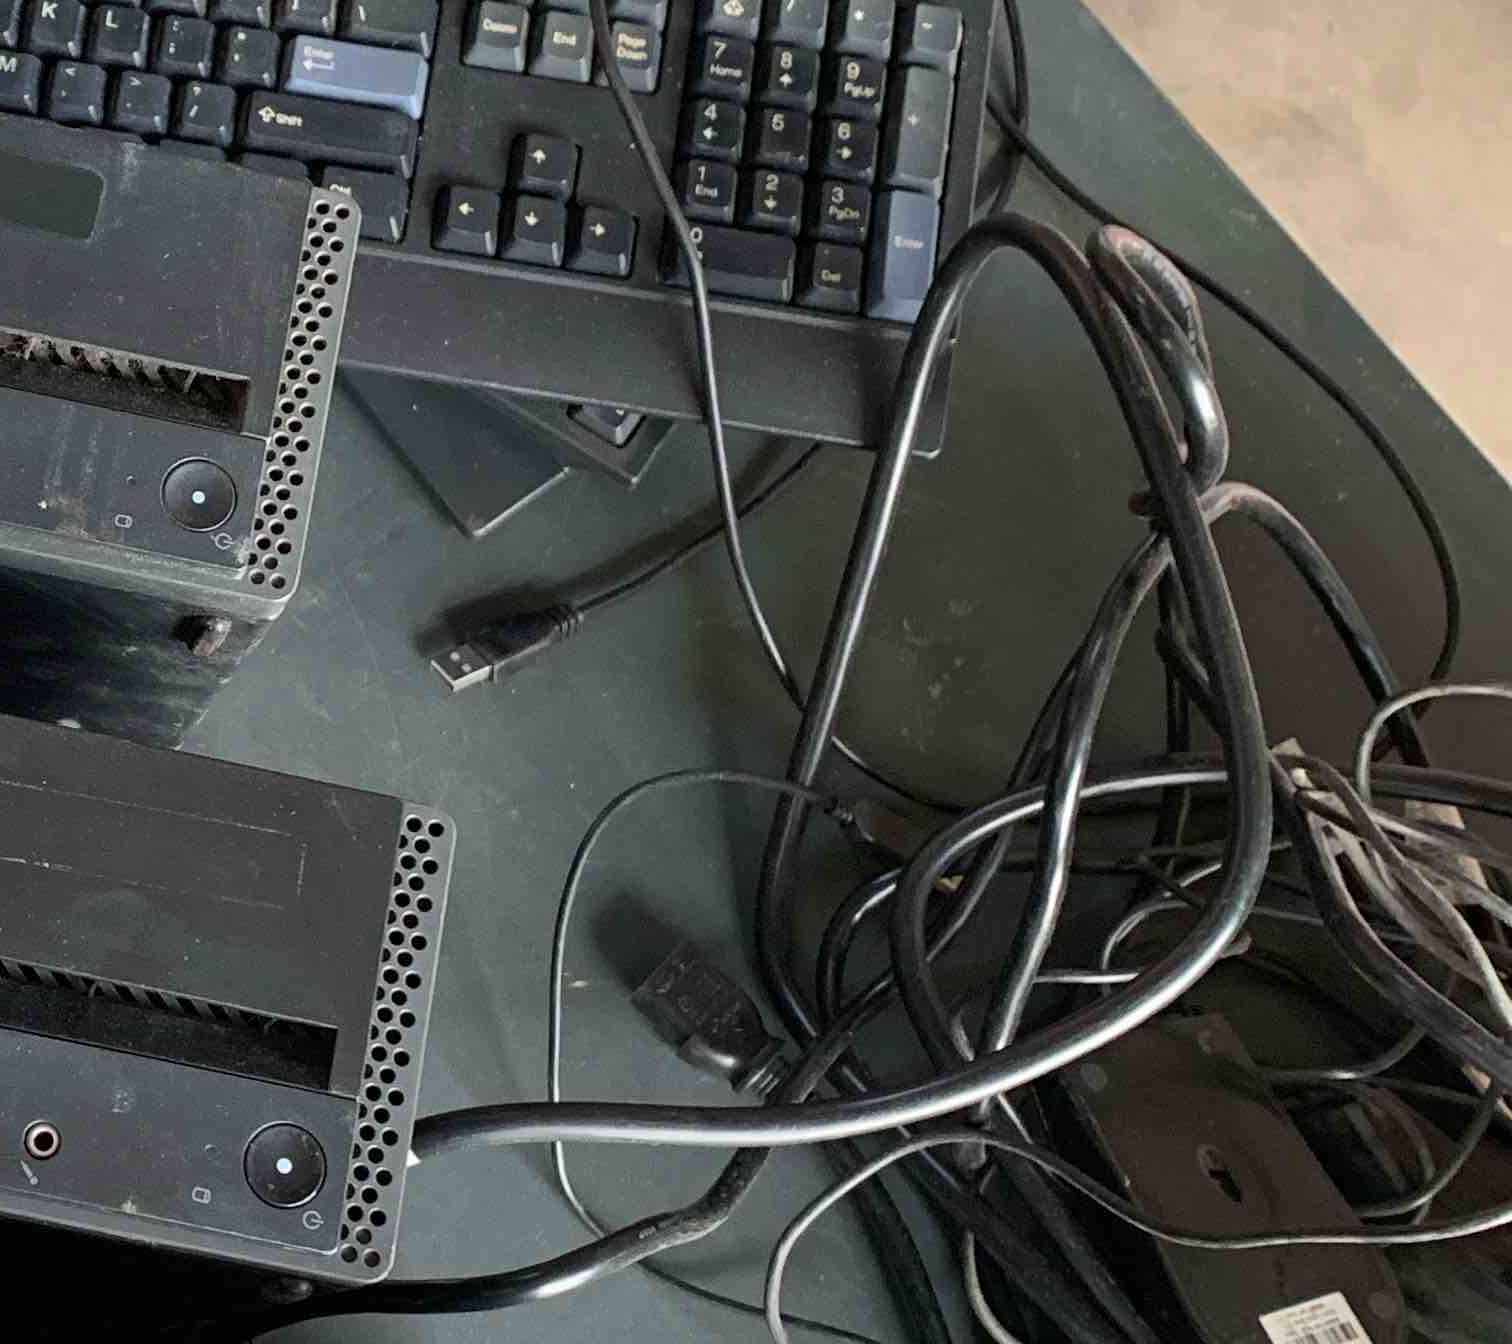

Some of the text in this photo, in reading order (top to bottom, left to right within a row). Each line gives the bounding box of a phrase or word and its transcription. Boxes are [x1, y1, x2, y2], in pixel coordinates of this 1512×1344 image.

[42, 2, 58, 19] K
[105, 11, 119, 28] L
[712, 43, 726, 58] 7
[781, 53, 792, 68] 8
[847, 63, 859, 79] 9
[704, 105, 716, 120] 4
[772, 115, 784, 130] 5
[838, 124, 850, 139] 6
[698, 167, 705, 182] 1
[765, 176, 778, 191] 2
[832, 188, 843, 203] 3
[690, 228, 703, 243] 0
